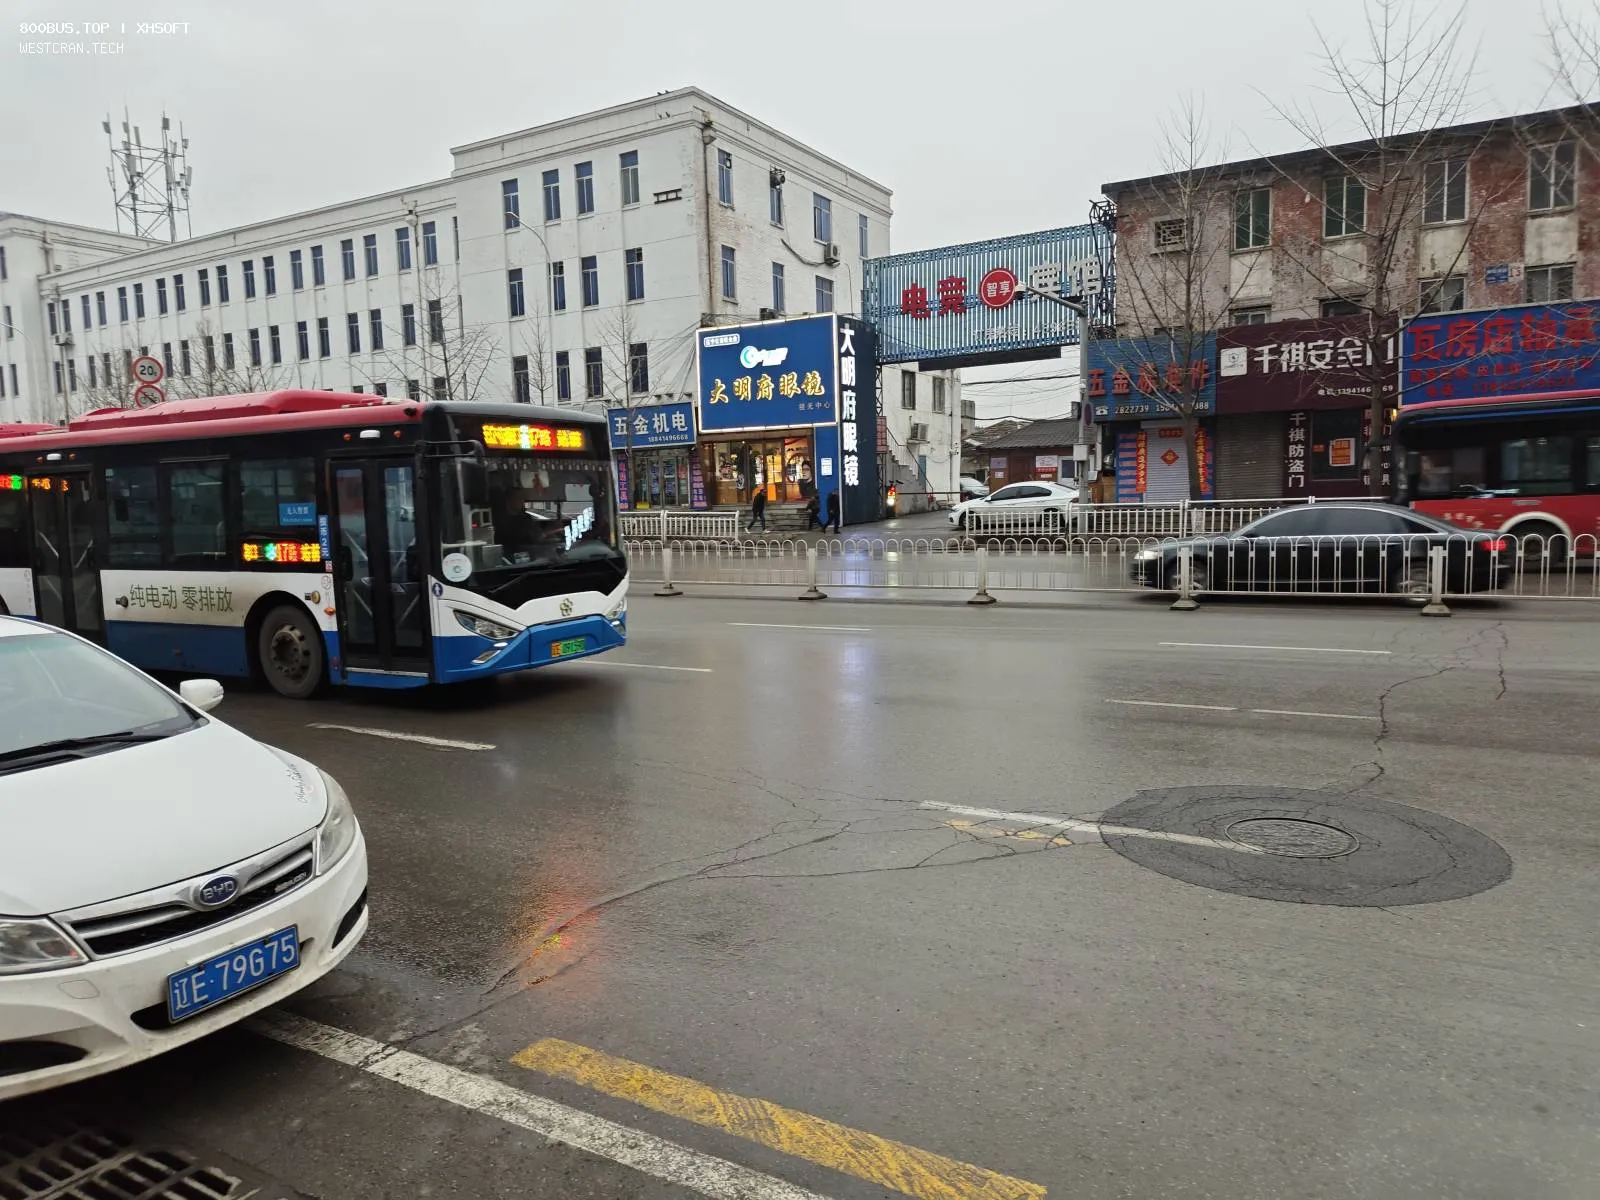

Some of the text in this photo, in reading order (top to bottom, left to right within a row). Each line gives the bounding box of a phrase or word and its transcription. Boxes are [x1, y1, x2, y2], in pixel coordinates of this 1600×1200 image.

[986, 280, 1013, 299] 智享
[1254, 333, 1395, 374] 千祺安全门
[709, 370, 826, 404] 大明府眼镜
[840, 322, 860, 487] 大明府眼镜
[614, 411, 689, 436] 五金机电
[1287, 412, 1307, 488] 千祺防盗门
[129, 584, 234, 613] 纯电动 零排放
[202, 880, 235, 900] BYD
